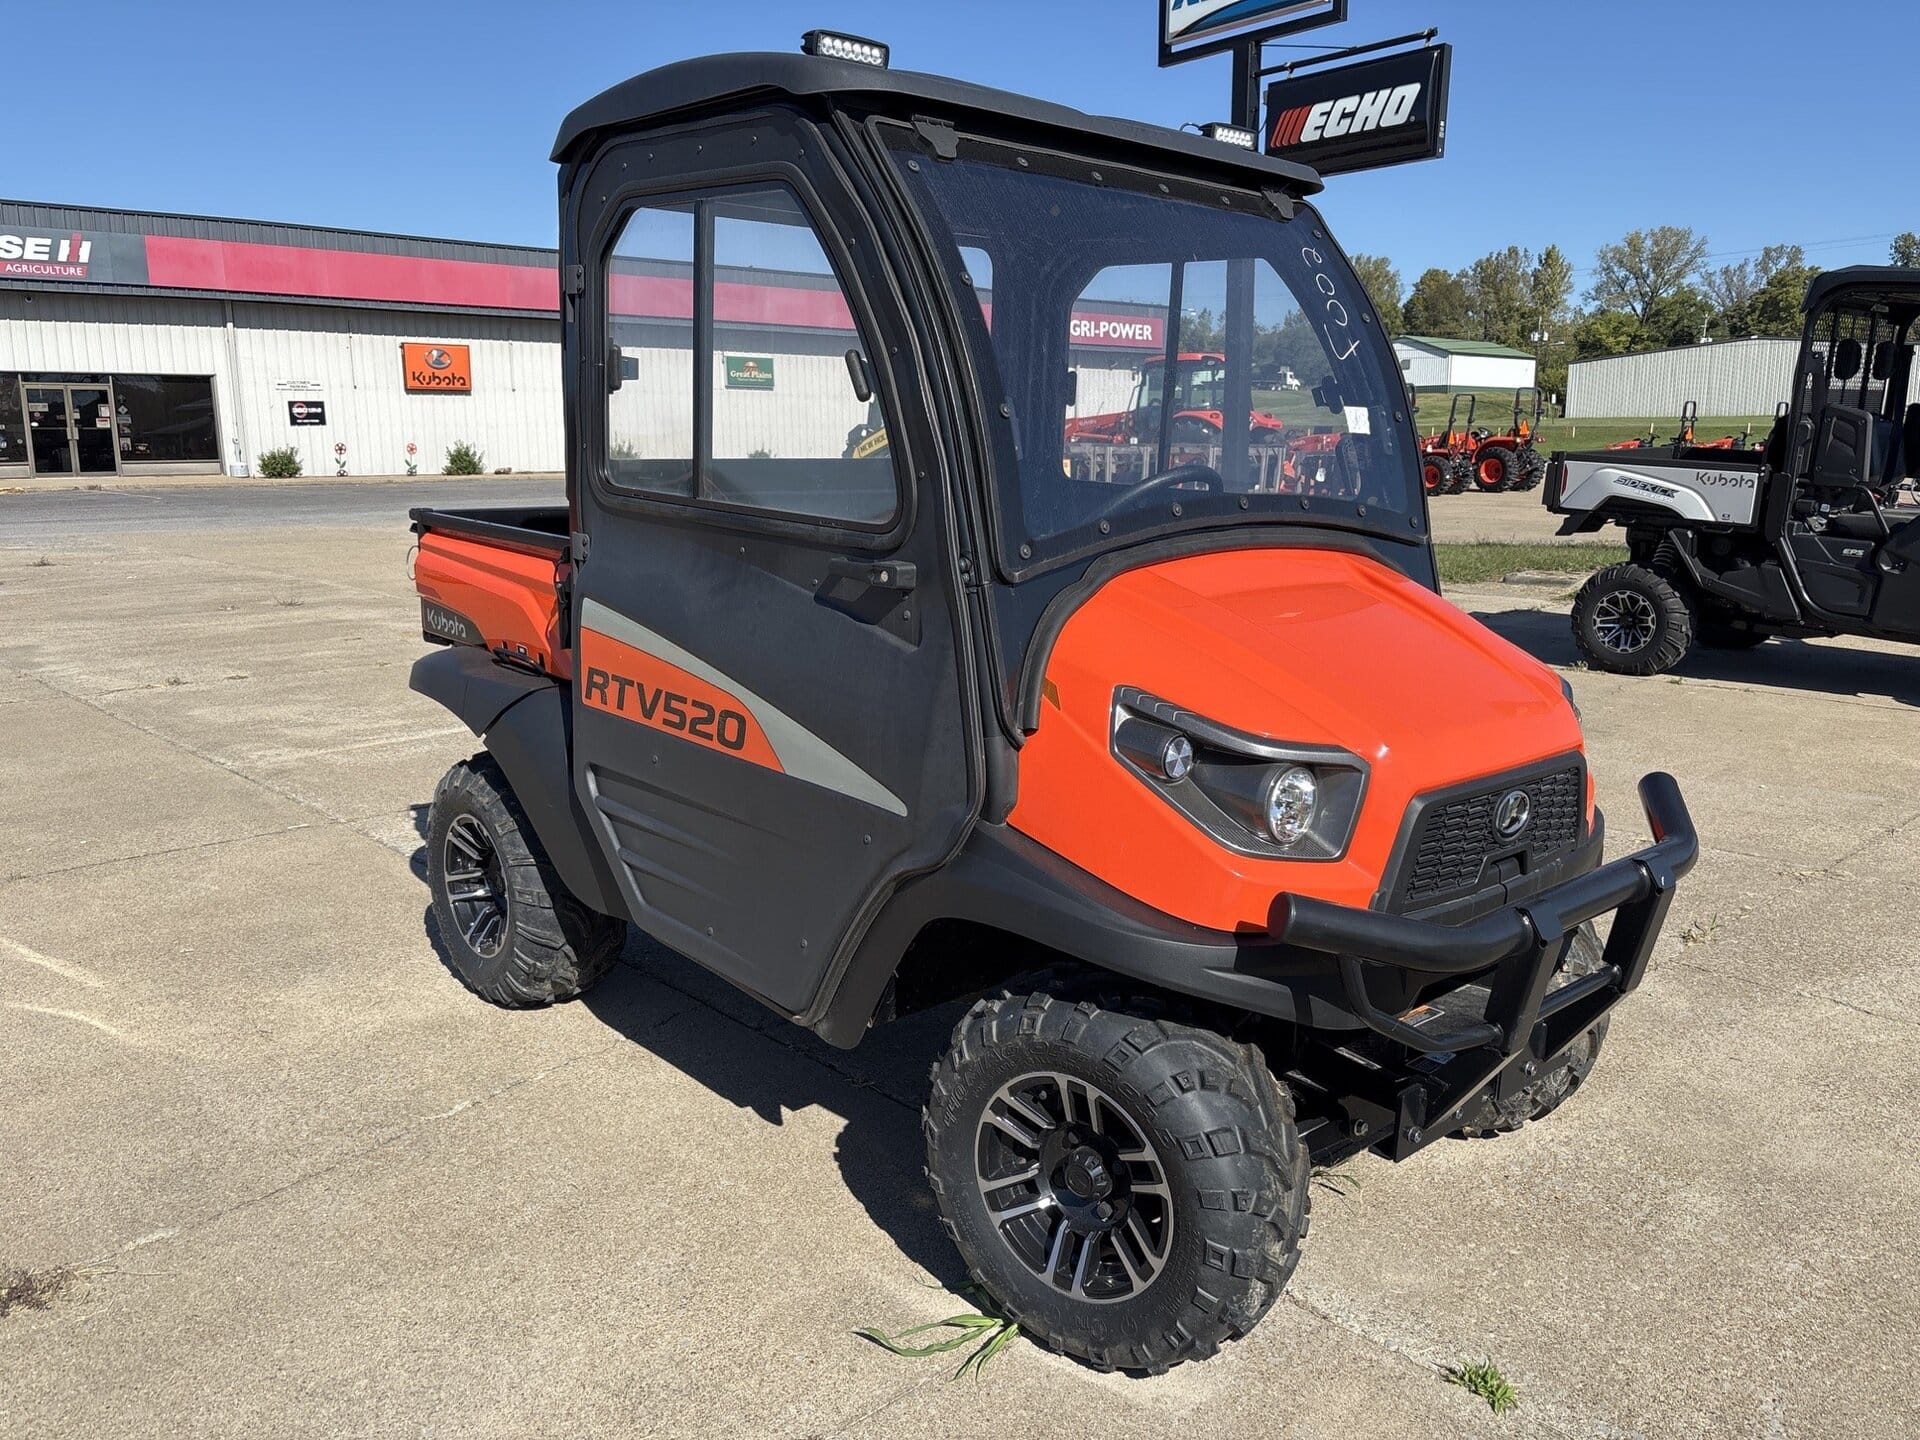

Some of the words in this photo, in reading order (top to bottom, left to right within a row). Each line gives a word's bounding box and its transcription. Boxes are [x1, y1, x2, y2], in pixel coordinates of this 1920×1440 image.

[1300, 83, 1421, 142] ECHO
[5, 263, 84, 276] AGRICULTURE
[1070, 319, 1153, 341] GRI-POWER
[412, 371, 467, 387] Kubota
[730, 370, 750, 378] Great
[1613, 475, 1680, 498] SIDEKICK
[1695, 471, 1755, 489] Kubota
[1842, 548, 1865, 558] EPS
[426, 607, 467, 638] Kubota
[584, 666, 747, 751] RTV520
